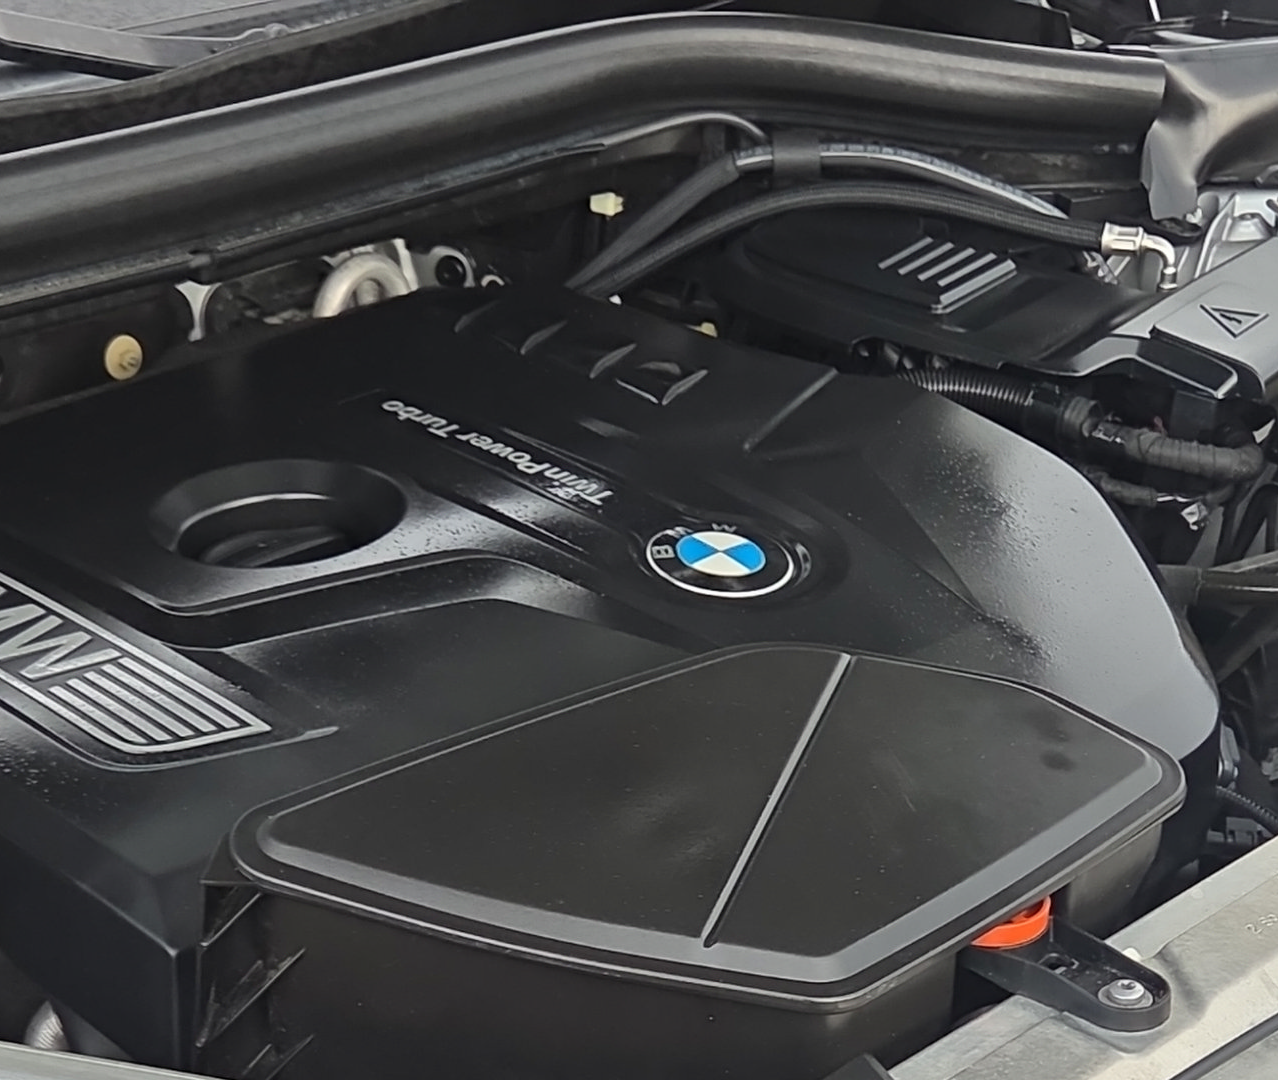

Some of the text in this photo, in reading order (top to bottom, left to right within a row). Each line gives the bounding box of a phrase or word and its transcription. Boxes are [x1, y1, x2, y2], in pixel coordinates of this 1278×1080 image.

[381, 400, 614, 505] TwinPower Turbo
[652, 522, 737, 559] BMW
